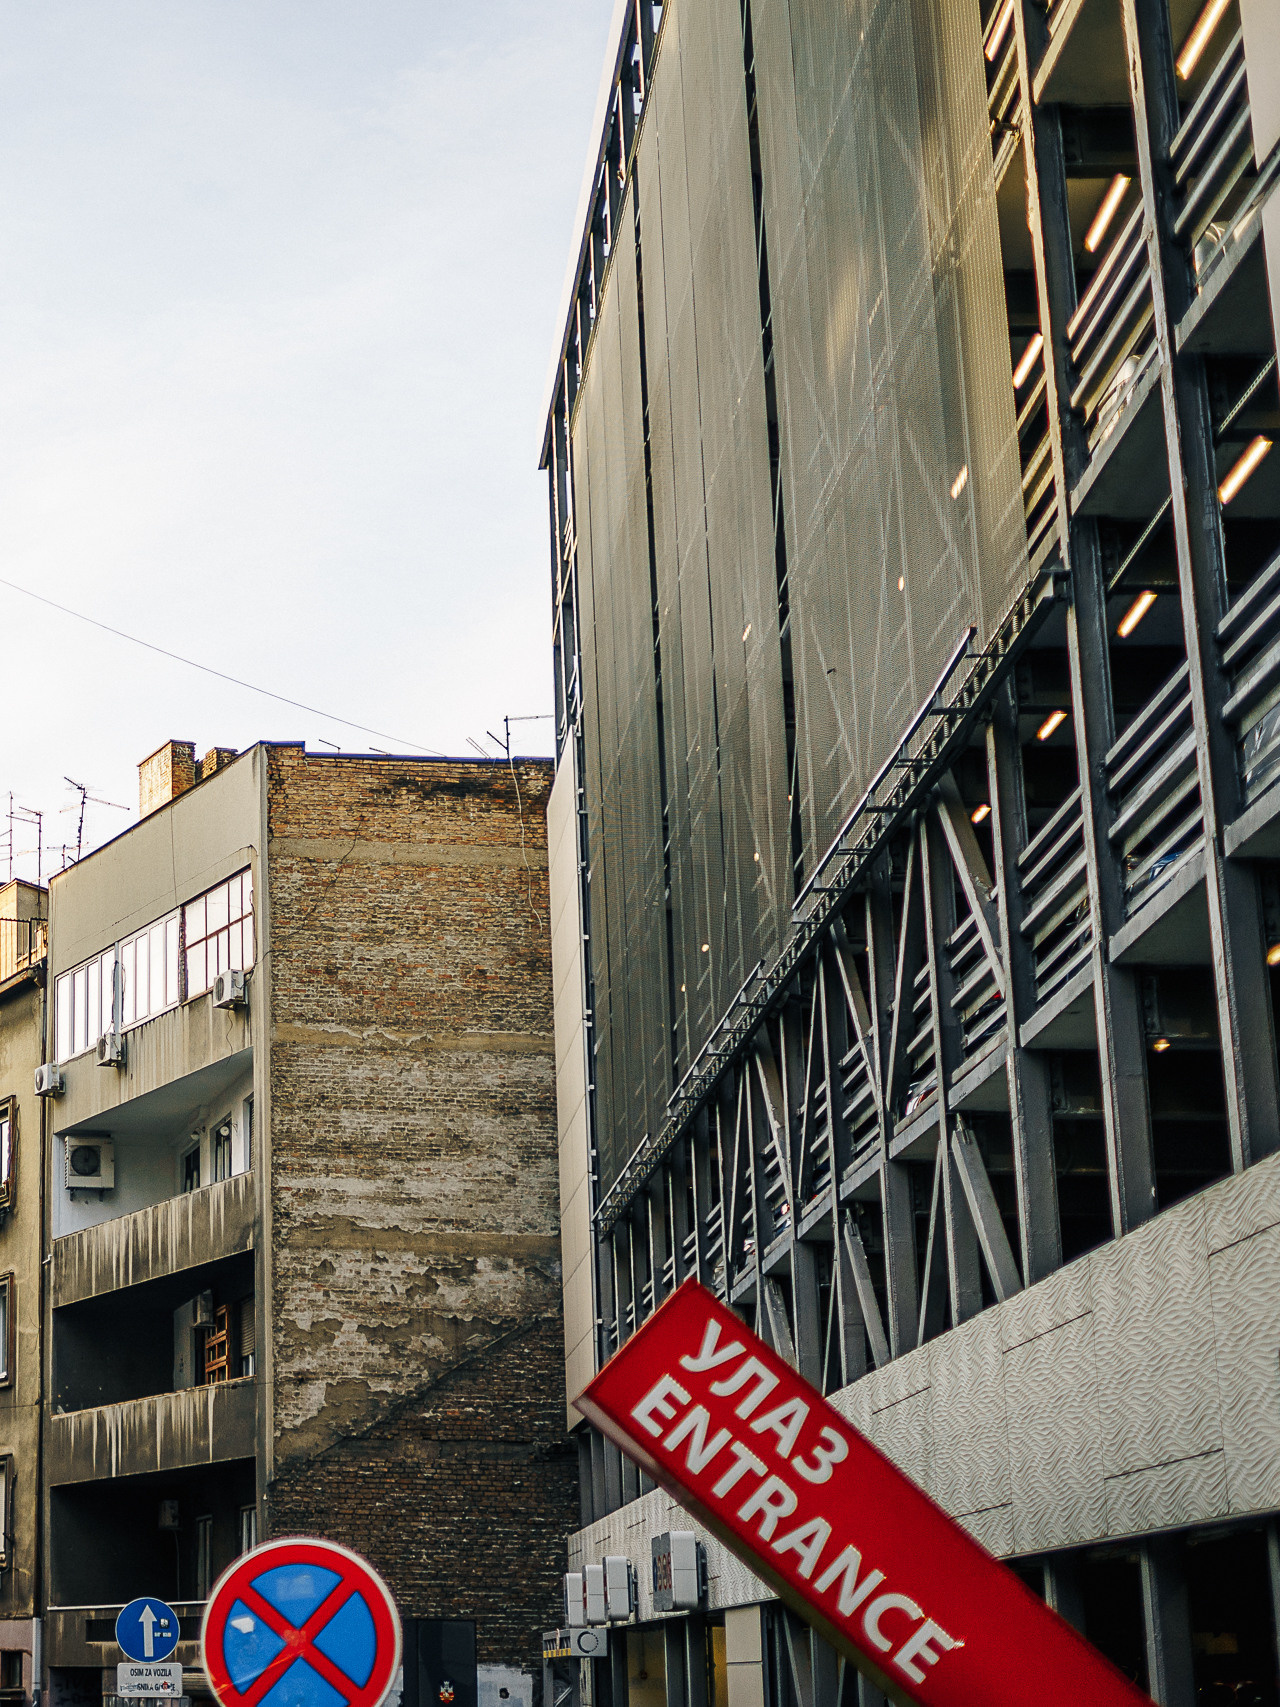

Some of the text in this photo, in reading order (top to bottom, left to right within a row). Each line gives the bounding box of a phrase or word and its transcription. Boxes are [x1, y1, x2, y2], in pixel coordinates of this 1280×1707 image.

[679, 1318, 849, 1484] УЛАЗ
[631, 1373, 958, 1685] ENTRANCE
[130, 1668, 172, 1677] OSIM ZA VOZILA
